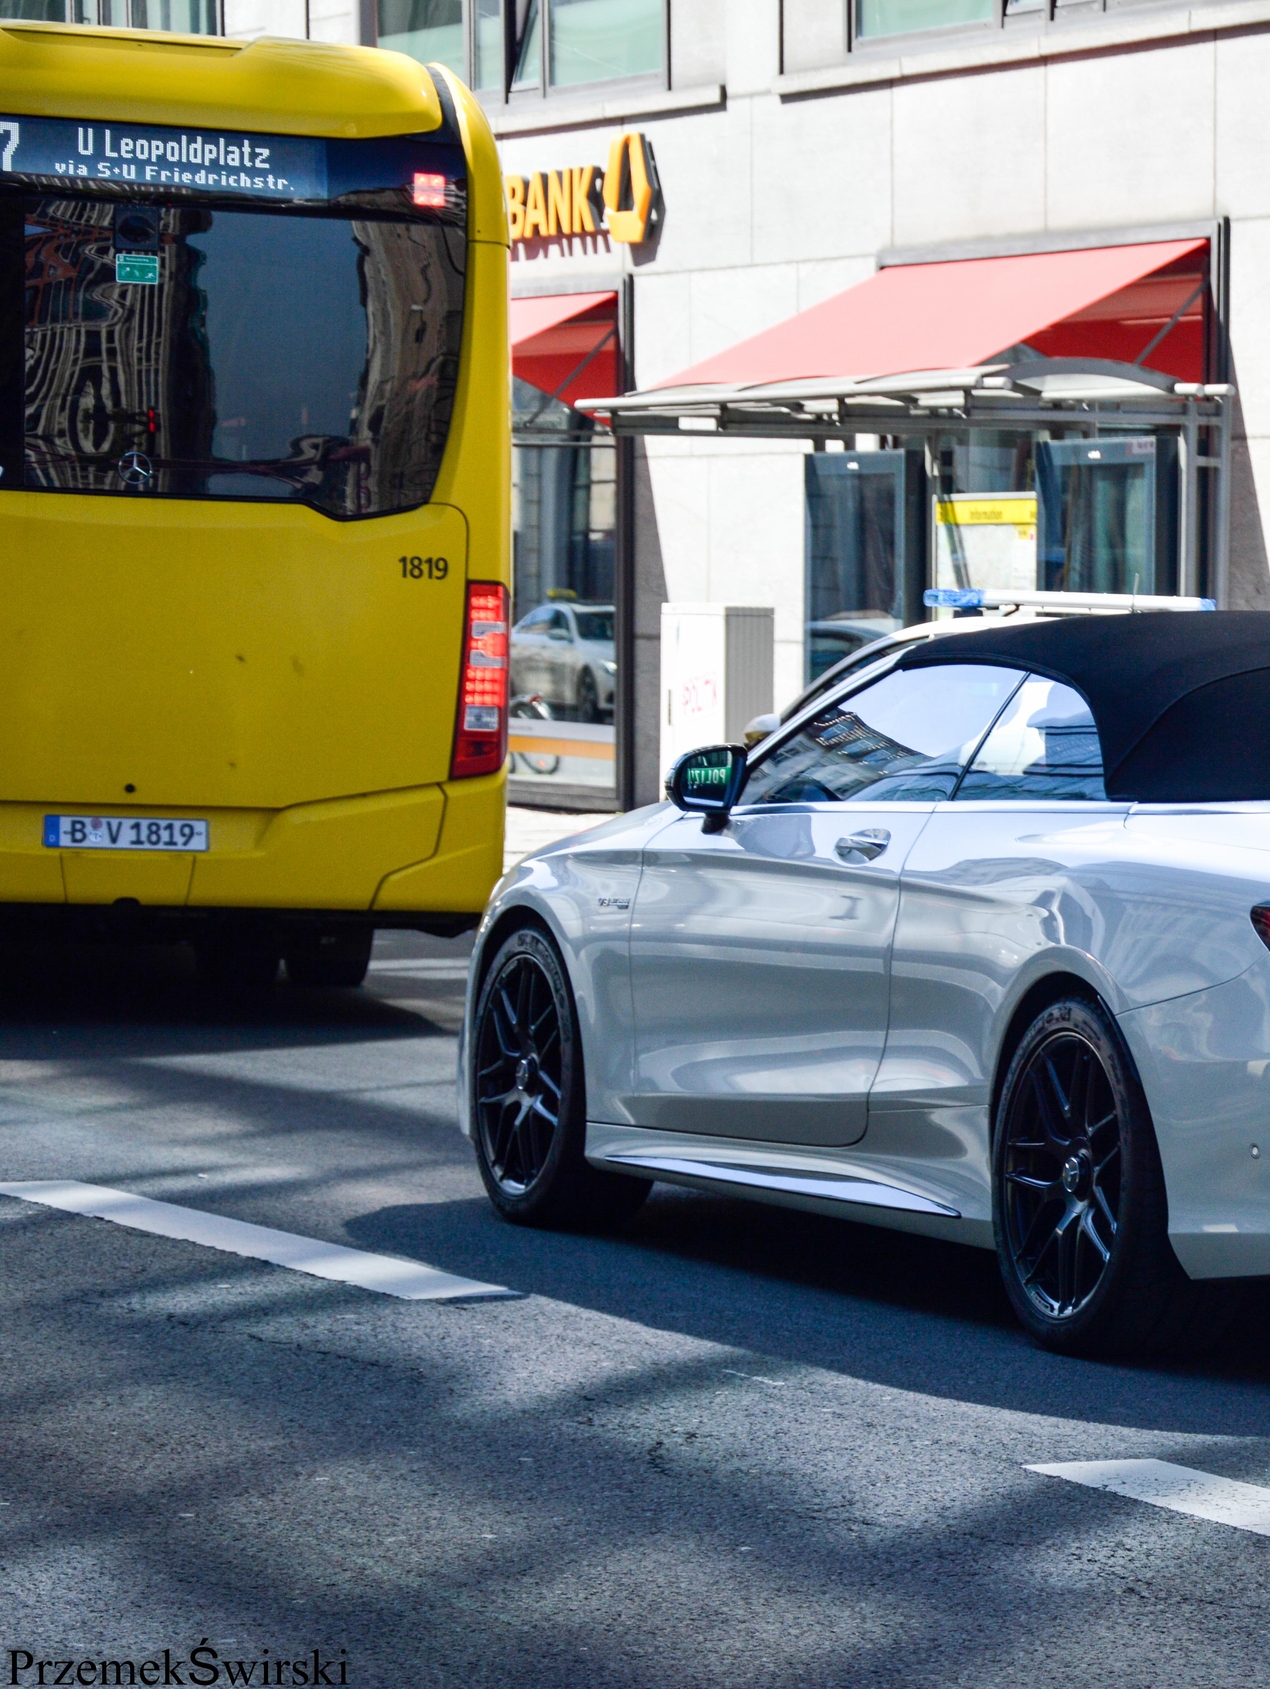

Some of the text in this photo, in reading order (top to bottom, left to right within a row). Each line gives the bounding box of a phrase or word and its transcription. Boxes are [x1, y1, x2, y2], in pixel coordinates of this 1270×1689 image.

[77, 126, 271, 169] U Leopoldplatz
[54, 160, 295, 191] via S+U Friedrichstr.
[399, 556, 448, 580] 1819
[70, 820, 195, 846] B V 1819
